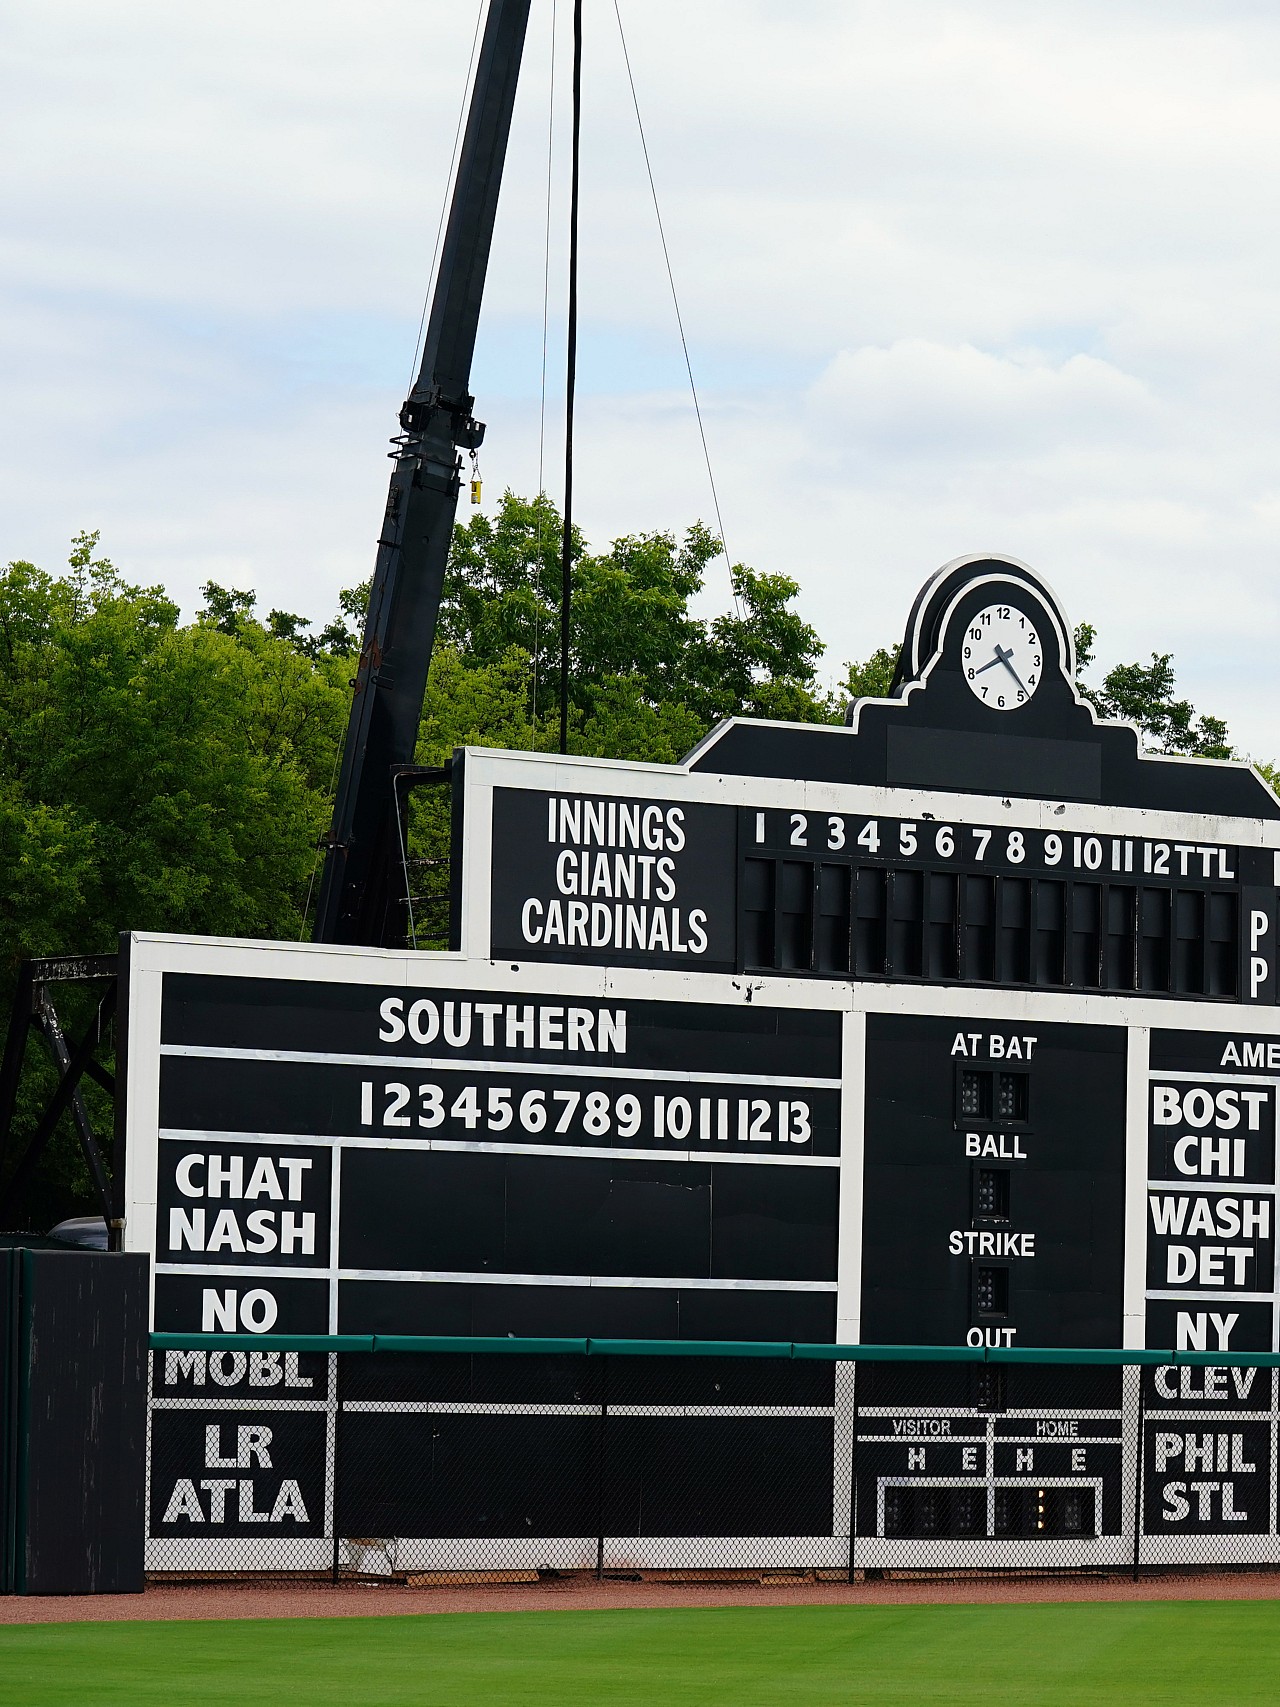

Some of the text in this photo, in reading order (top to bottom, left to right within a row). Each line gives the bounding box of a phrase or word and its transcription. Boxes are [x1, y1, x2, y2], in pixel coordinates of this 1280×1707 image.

[980, 613, 990, 625] 11
[997, 607, 1010, 619] 12
[1019, 617, 1024, 628] 1
[969, 628, 981, 640] 10
[1029, 633, 1036, 644] 2
[964, 647, 971, 659] 9
[1034, 655, 1040, 666] 3
[968, 668, 975, 679] 8
[1028, 675, 1035, 686] 4
[981, 687, 988, 698] 7
[998, 696, 1004, 707] 6
[1017, 691, 1024, 702] 5
[549, 798, 685, 851] INNINGS
[756, 813, 1234, 878] 1 2 3 4 5 6 7 8 9 10 11 12 TTL
[557, 850, 675, 901] GIANTS
[522, 898, 707, 953] CARDINALS
[1250, 911, 1268, 951] P
[1250, 957, 1268, 998] P
[380, 998, 626, 1053] SOUTHERN
[951, 1033, 1037, 1059] AT BAT
[1153, 1087, 1268, 1130] BOST
[966, 1134, 1026, 1158] BALL
[1174, 1136, 1245, 1176] CHI
[176, 1154, 312, 1201] CHAT
[169, 1208, 315, 1254] NASH
[1149, 1196, 1269, 1238] WASH
[949, 1231, 1035, 1256] STRIKE
[1167, 1245, 1253, 1285] DET
[202, 1289, 277, 1333] NO
[967, 1327, 1016, 1347] OUT
[1177, 1312, 1239, 1350] NY
[165, 1351, 313, 1387] MOBL
[1154, 1366, 1257, 1399] CLEV
[205, 1425, 273, 1468] LR
[892, 1420, 1079, 1437] VISITOR HOME
[908, 1447, 1087, 1472] H E H E
[1155, 1433, 1256, 1472] PHIL
[162, 1479, 310, 1523] ATLA
[1163, 1482, 1247, 1521] STL
